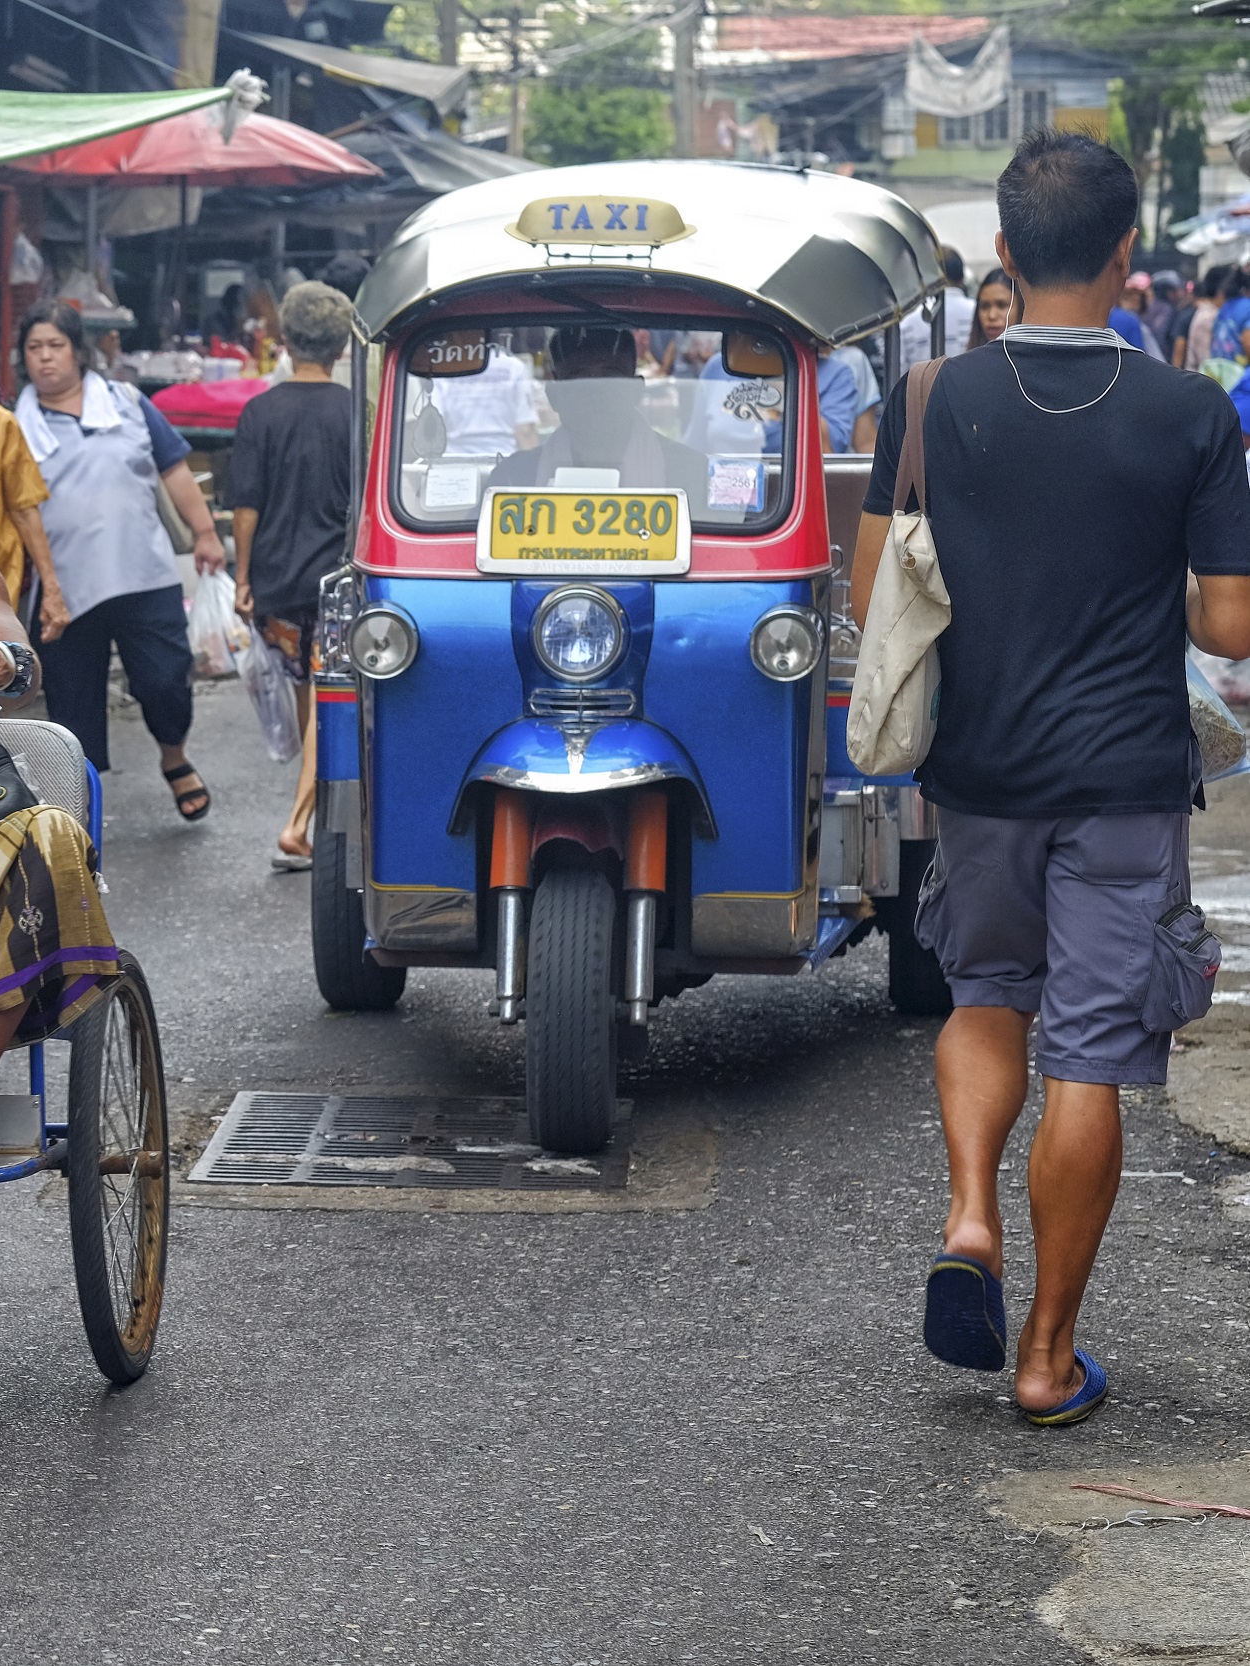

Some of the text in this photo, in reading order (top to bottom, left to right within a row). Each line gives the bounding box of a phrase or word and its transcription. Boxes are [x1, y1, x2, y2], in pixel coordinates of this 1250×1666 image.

[547, 203, 649, 231] TAXI
[572, 498, 673, 536] 3280
[518, 547, 649, 560] กรงเทพมหานคร
